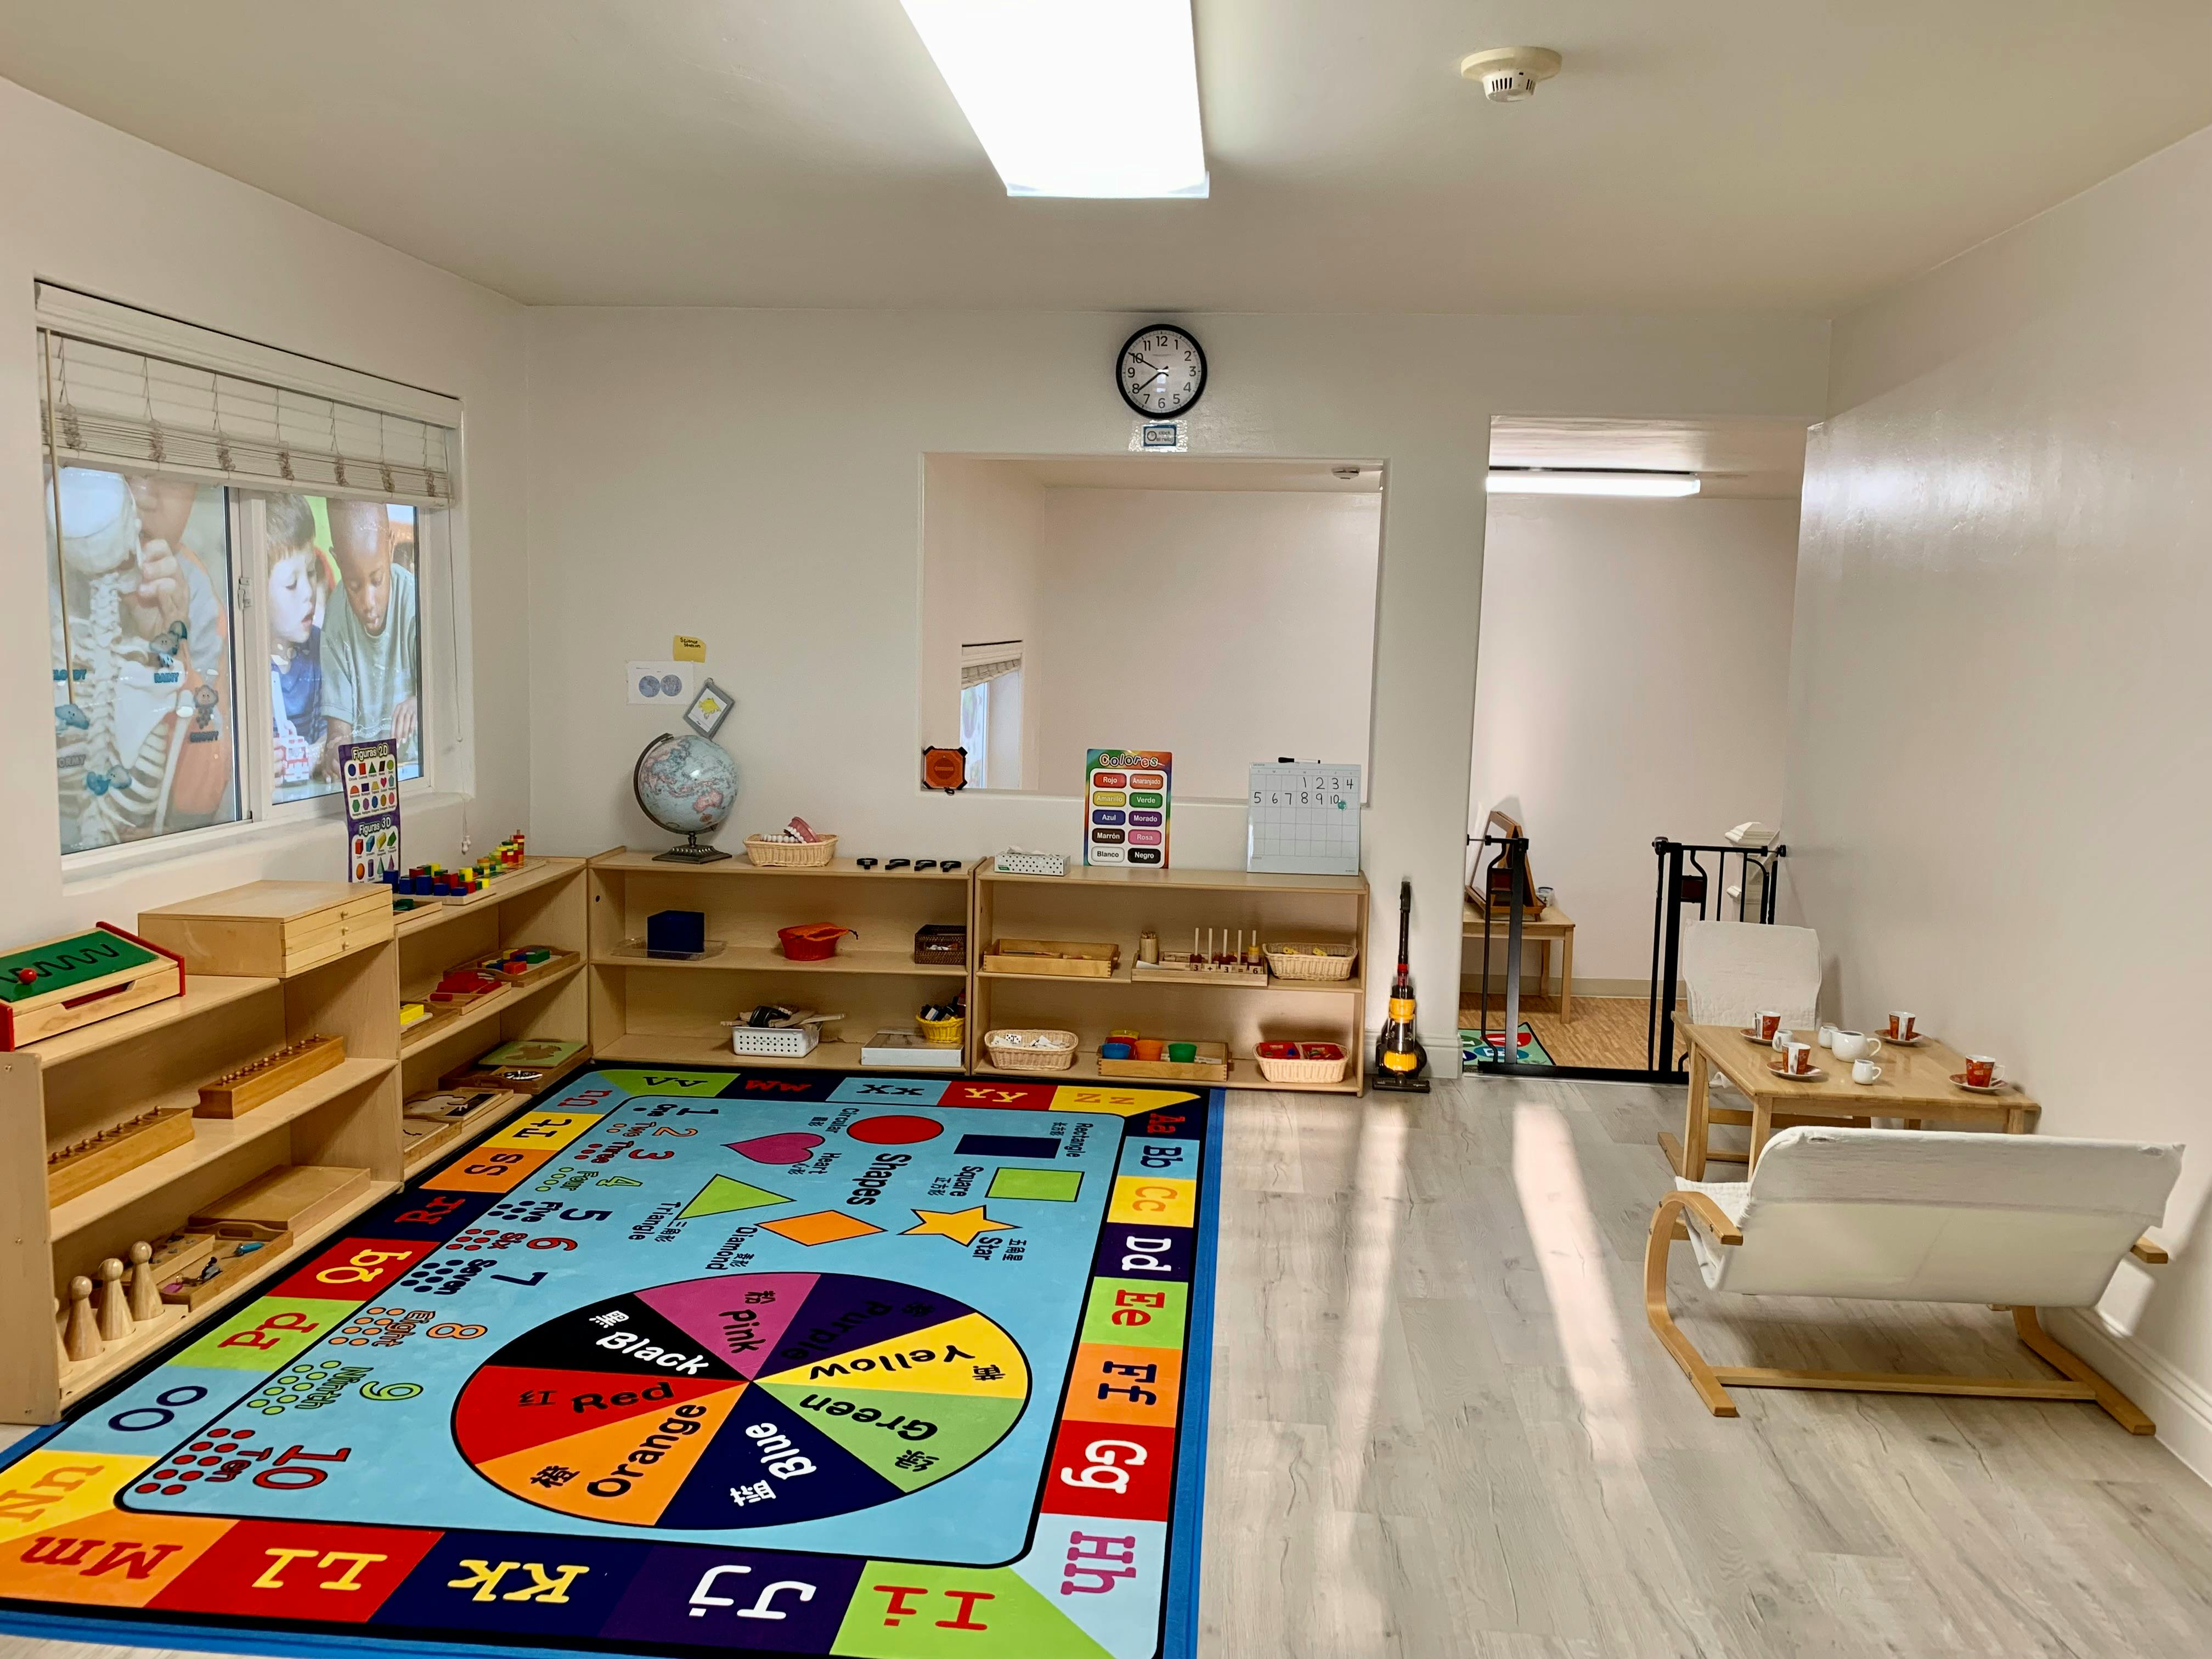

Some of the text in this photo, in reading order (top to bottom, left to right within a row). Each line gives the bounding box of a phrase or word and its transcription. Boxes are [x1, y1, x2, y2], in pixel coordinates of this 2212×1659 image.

[1143, 341, 1150, 351] 11
[1156, 336, 1167, 347] 12
[1175, 340, 1178, 350] 1
[1132, 353, 1143, 363] 10
[1184, 351, 1192, 362] 2
[1128, 368, 1135, 378] 9
[1189, 366, 1197, 376] 3
[1132, 383, 1139, 394] 8
[1183, 382, 1192, 392] 4
[1143, 394, 1150, 404] 7
[1158, 398, 1165, 408] 6
[1173, 394, 1180, 404] 5
[353, 744, 388, 761] Figuras 2D
[1099, 753, 1159, 768] Colores
[1103, 776, 1118, 785] Rojo
[1132, 777, 1161, 786] Anaranjado
[1303, 776, 1353, 789] 1 2 3 4
[1254, 792, 1339, 805] 5 6 7 8 9 10
[359, 816, 391, 837] Figuras 3D
[643, 1076, 708, 1087] Vv
[744, 1079, 812, 1092] Ww
[856, 1084, 925, 1096] Xx
[557, 1090, 613, 1107] Uu
[964, 1088, 1028, 1103] Yy
[1074, 1093, 1135, 1105] Zz
[646, 1103, 678, 1117] One
[676, 1107, 719, 1116] 1
[825, 1107, 860, 1133] Circular
[512, 1119, 573, 1138] Tt
[622, 1121, 657, 1137] Two
[652, 1127, 698, 1137] 2
[1147, 1113, 1186, 1134] Aa
[1064, 1122, 1094, 1158] Rectangle
[591, 1141, 635, 1164] Three
[628, 1149, 675, 1160] 3
[1140, 1145, 1183, 1168] Bb
[464, 1153, 524, 1176] Ss
[787, 1162, 810, 1175] 心形
[808, 1152, 842, 1175] Heart
[560, 1171, 599, 1191] Four
[595, 1176, 643, 1187] 4
[846, 1153, 912, 1206] Shapes
[927, 1176, 952, 1197] 正方形
[949, 1165, 985, 1198] Square
[1132, 1186, 1178, 1212] Cc
[394, 1197, 466, 1224] Rr
[520, 1201, 564, 1223] Five
[559, 1208, 613, 1221] 5
[628, 1201, 681, 1240] Triangle
[487, 1232, 528, 1250] Six
[654, 1221, 687, 1242] 三角形
[526, 1237, 578, 1251] 6
[705, 1227, 758, 1270] Diamond
[972, 1236, 1003, 1261] Star
[1002, 1238, 1027, 1261] 五角星
[1122, 1236, 1172, 1272] Dd
[316, 1249, 413, 1284] Qq
[433, 1259, 498, 1295] Seven
[490, 1272, 549, 1286] 7
[744, 1290, 776, 1305] 粉
[1111, 1289, 1165, 1326] Ee
[371, 1310, 436, 1347] Eight
[589, 1310, 630, 1329] 黑
[217, 1312, 319, 1350] Pp
[426, 1323, 488, 1340] 8
[718, 1308, 767, 1354] Pink
[780, 1301, 893, 1360] Purple
[595, 1331, 709, 1375] Black
[809, 1345, 976, 1380] Yellow
[972, 1364, 1006, 1381] 黄
[294, 1366, 375, 1409] Ninth
[359, 1381, 424, 1401] 9
[1097, 1361, 1158, 1406] Ff
[518, 1389, 558, 1408] 红
[571, 1381, 675, 1414] Red
[108, 1386, 208, 1431] Oo
[799, 1393, 939, 1441] Green
[586, 1403, 708, 1498] Orange
[745, 1422, 817, 1481] Blue
[894, 1449, 940, 1472] 绿
[204, 1447, 274, 1483] Ten
[252, 1444, 352, 1490] 10
[1060, 1440, 1148, 1494] Gg
[529, 1465, 581, 1489] 橙
[729, 1479, 777, 1507] 蓝
[20, 1537, 183, 1579] Mm
[1060, 1531, 1137, 1595] Hh
[252, 1548, 388, 1590] Ll
[447, 1559, 590, 1604] Kk
[689, 1565, 817, 1620] Jj
[873, 1585, 996, 1630] Ii
